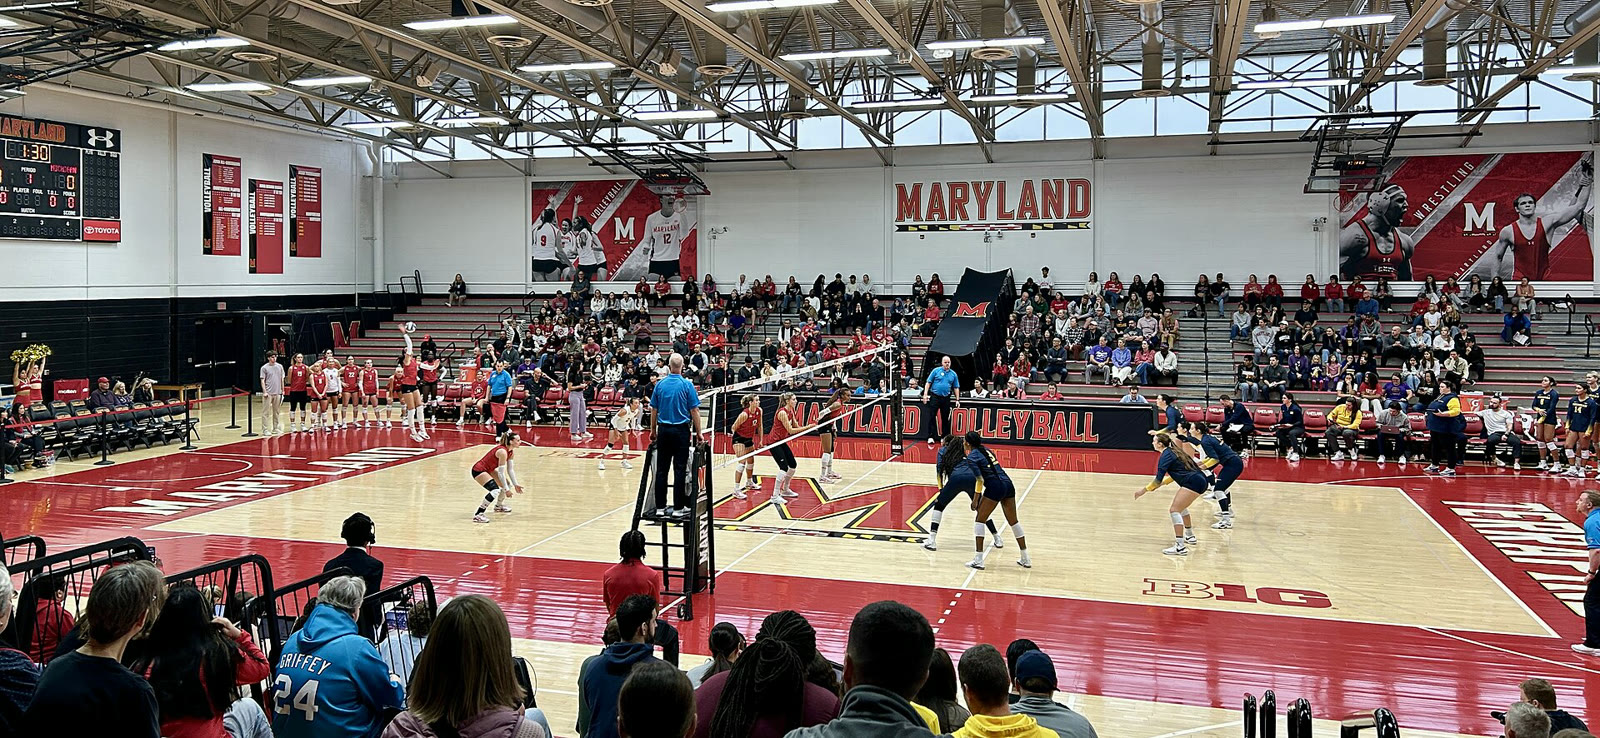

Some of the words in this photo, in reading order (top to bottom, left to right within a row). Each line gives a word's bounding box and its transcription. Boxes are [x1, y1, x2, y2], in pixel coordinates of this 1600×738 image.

[0, 117, 66, 143] ARYLAND
[23, 144, 49, 160] 1:30
[66, 175, 75, 189] 0
[203, 167, 211, 213] VOLLEYBALL
[1413, 160, 1475, 220] WRESTLING
[49, 195, 57, 207] 0
[67, 197, 75, 209] 0
[590, 181, 624, 220] VOLLEYBALL
[895, 178, 1092, 222] MARYLAND
[614, 217, 636, 241] M
[653, 223, 681, 234] MARYLAND
[1463, 202, 1496, 232] M
[540, 235, 547, 247] 9
[663, 233, 672, 245] 12
[1453, 239, 1493, 276] MARYLAND
[951, 301, 991, 318] M
[936, 407, 1099, 443] OLLEYBALL
[93, 446, 435, 516] MARYLAND
[279, 653, 332, 675] GRIFFEY
[273, 673, 319, 721] 24
